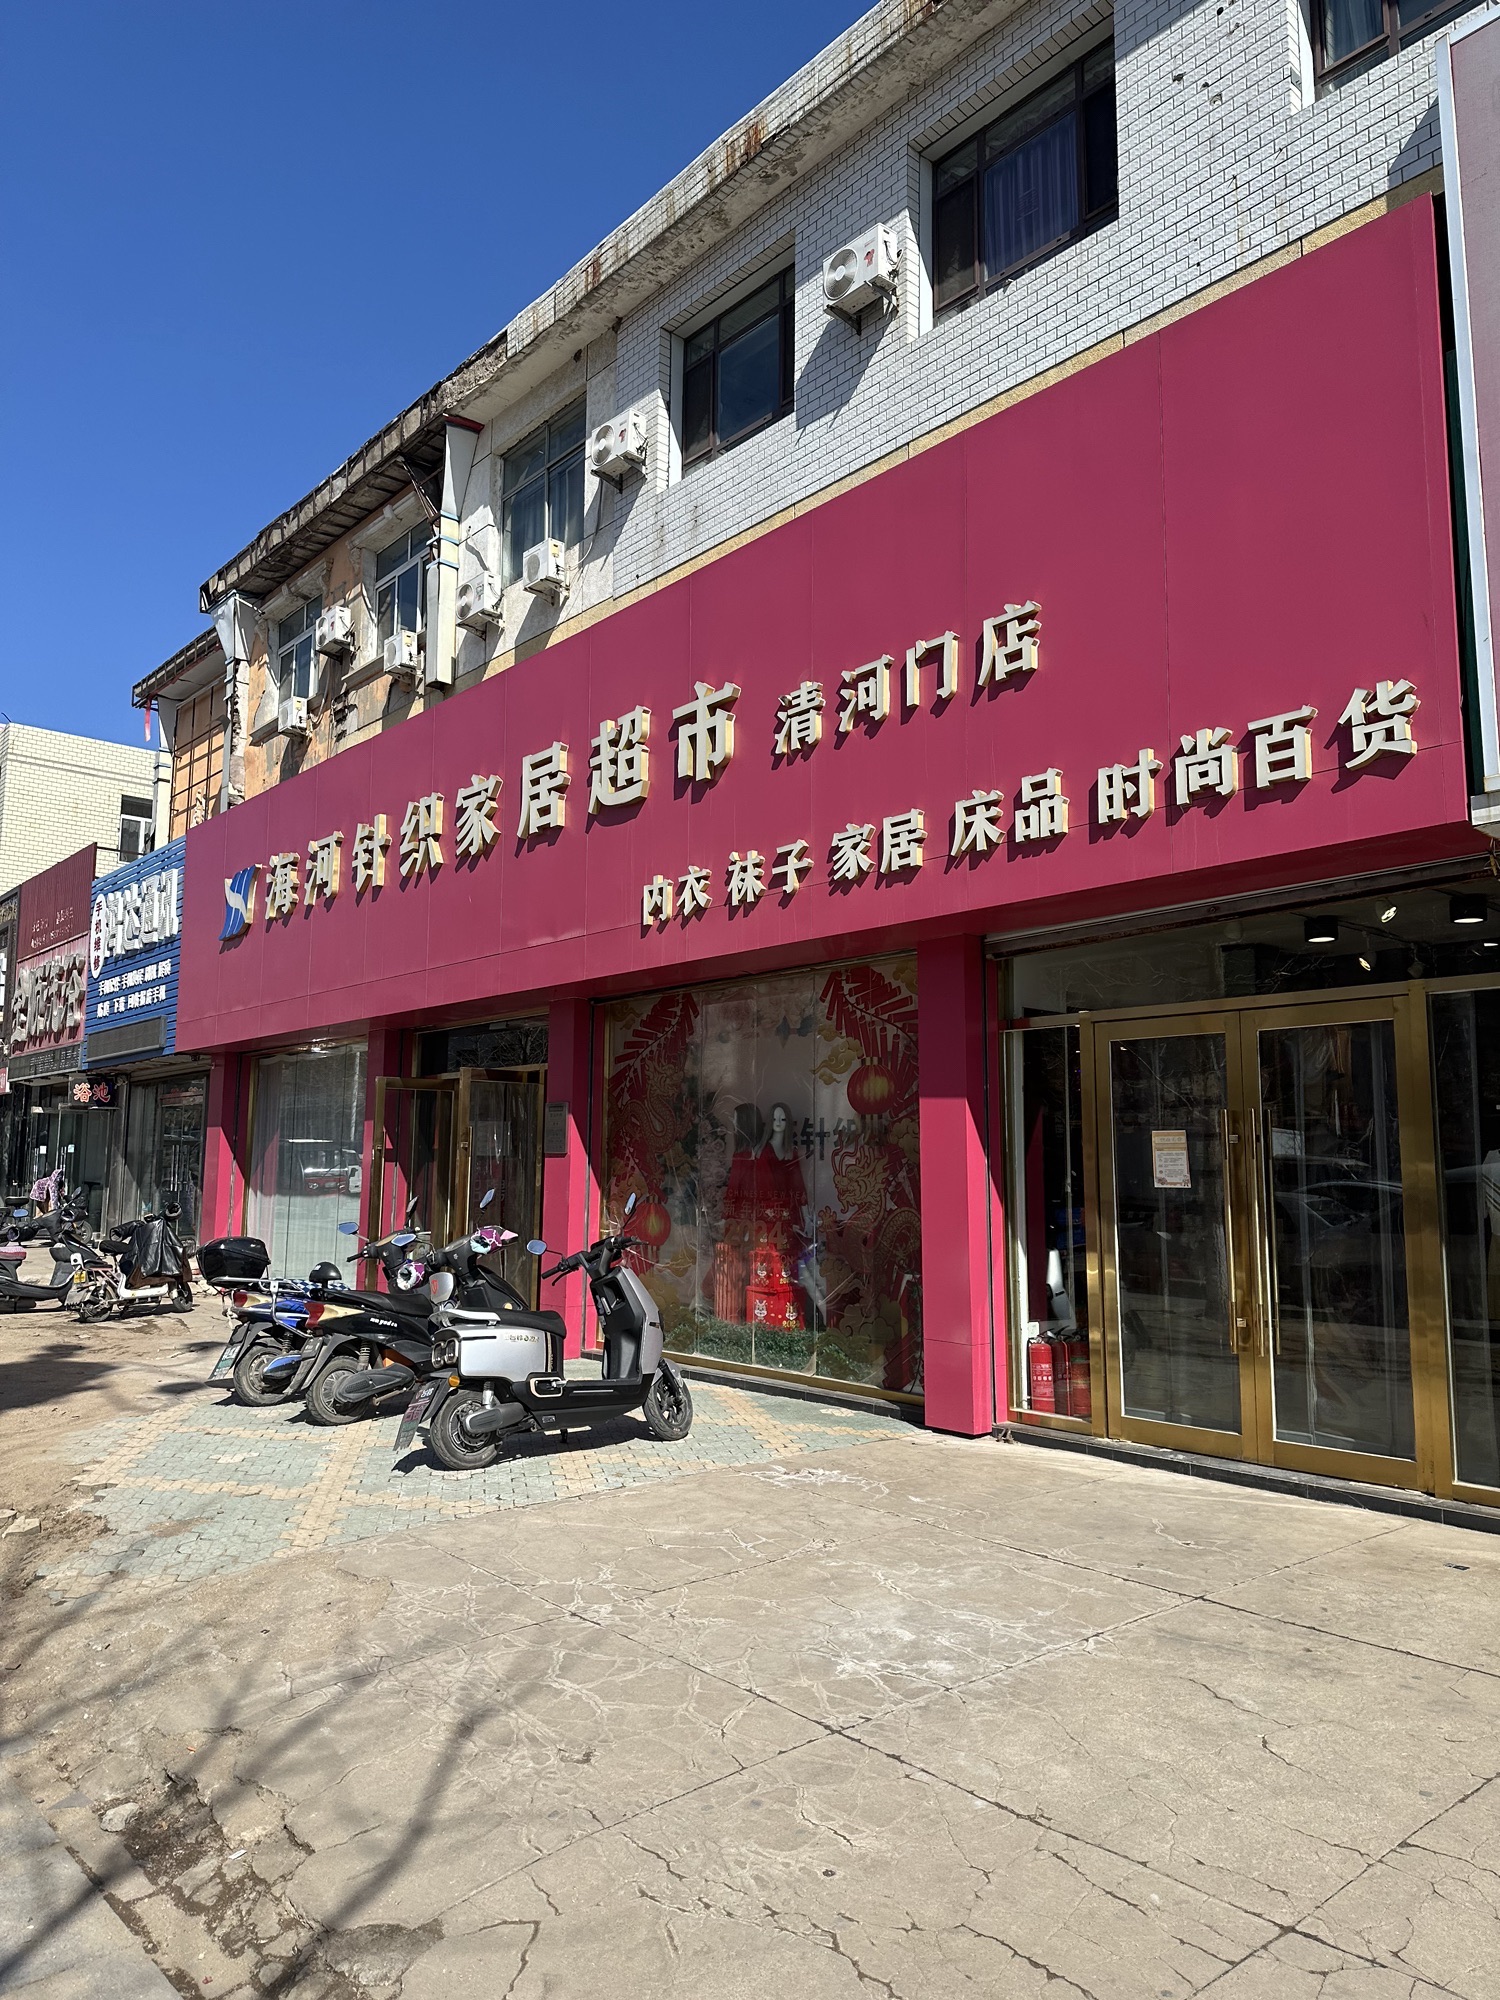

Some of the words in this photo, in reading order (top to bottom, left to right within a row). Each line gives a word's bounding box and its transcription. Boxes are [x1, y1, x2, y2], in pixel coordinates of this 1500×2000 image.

[265, 680, 742, 920] 海河针织家居超市
[774, 600, 1042, 755] 清河门店
[642, 865, 713, 926] 内衣
[727, 838, 814, 907] 袜子
[832, 808, 928, 882] 家居
[950, 767, 1070, 857] 床品
[1097, 678, 1421, 824] 时尚百货
[93, 900, 103, 972] 手机维修
[73, 1082, 111, 1103] 浴池
[722, 1198, 785, 1218] 新年快乐
[727, 1189, 765, 1199] CHINESE
[767, 1190, 787, 1200] NEW
[723, 1217, 785, 1250] 2024
